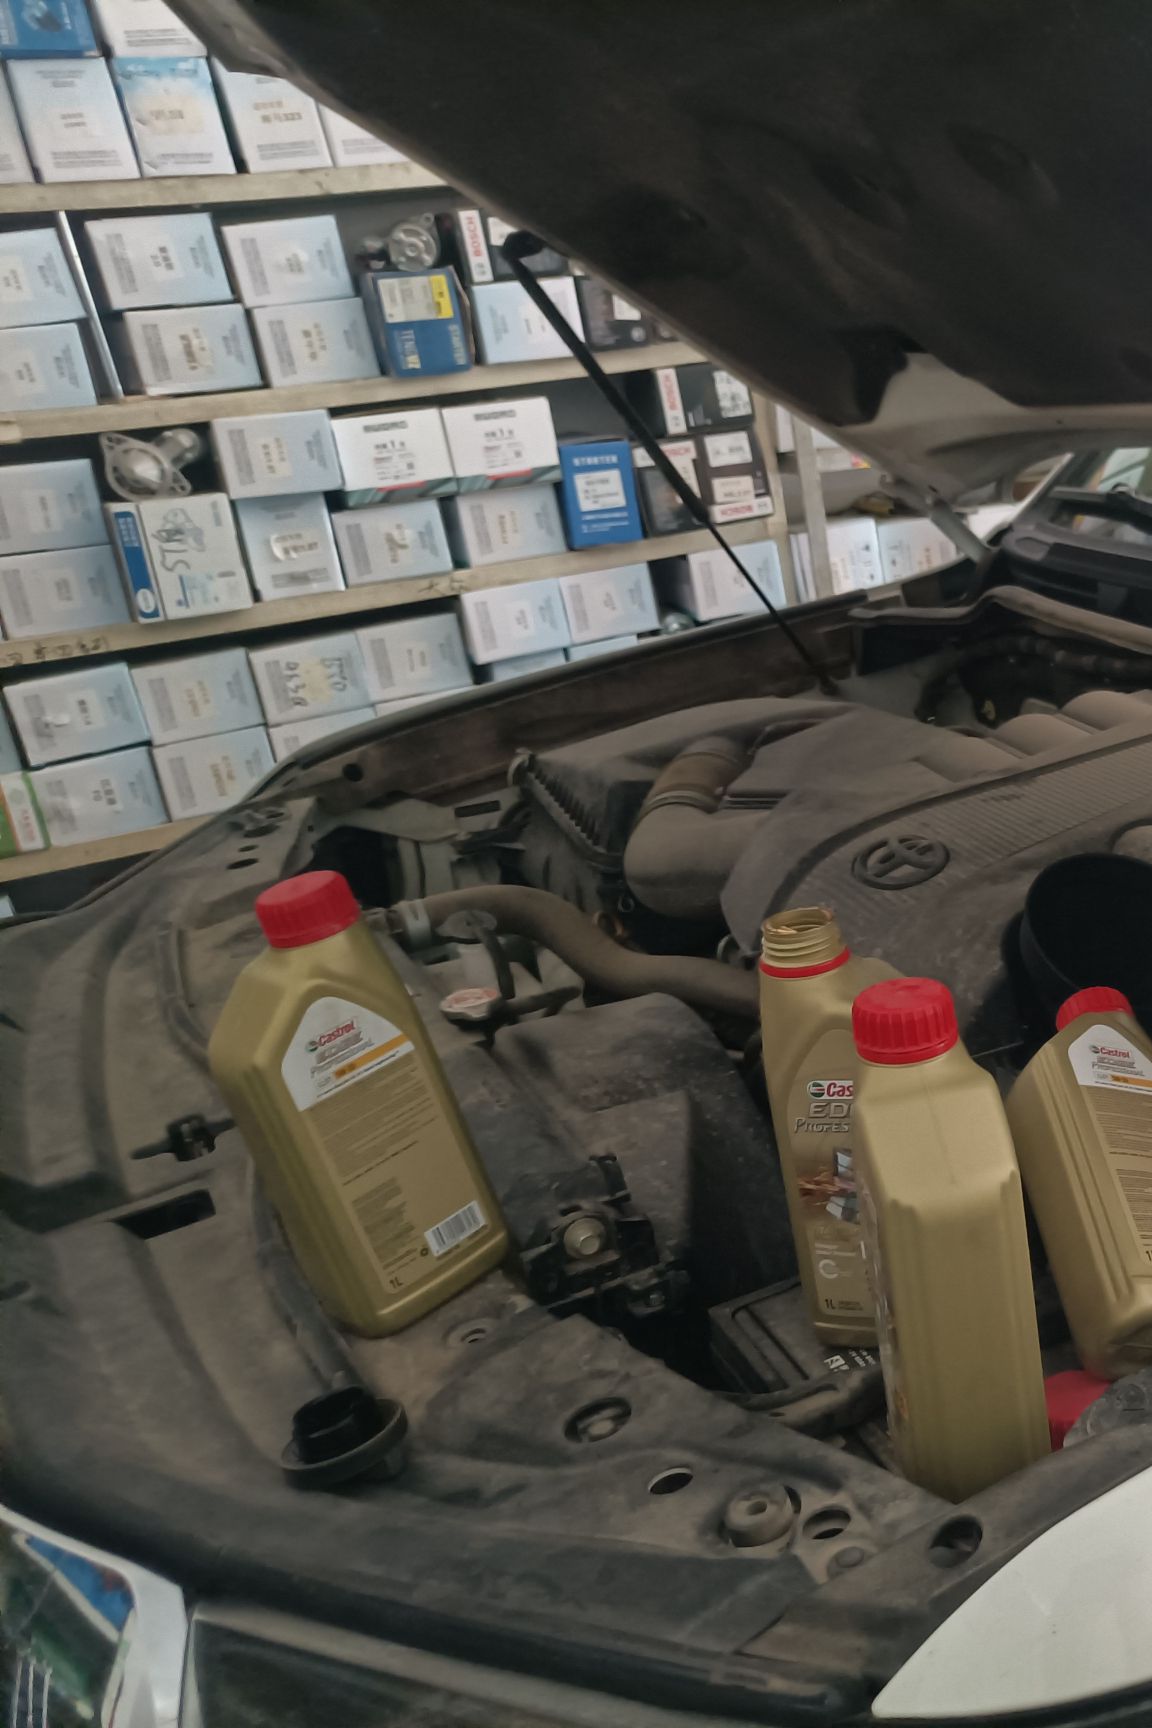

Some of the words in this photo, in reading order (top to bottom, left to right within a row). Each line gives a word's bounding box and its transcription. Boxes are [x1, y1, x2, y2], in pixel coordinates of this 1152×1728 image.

[319, 1020, 356, 1047] Castrol
[1100, 1046, 1130, 1058] Castrol
[808, 1102, 854, 1119] ED
[389, 1276, 404, 1289] 1L
